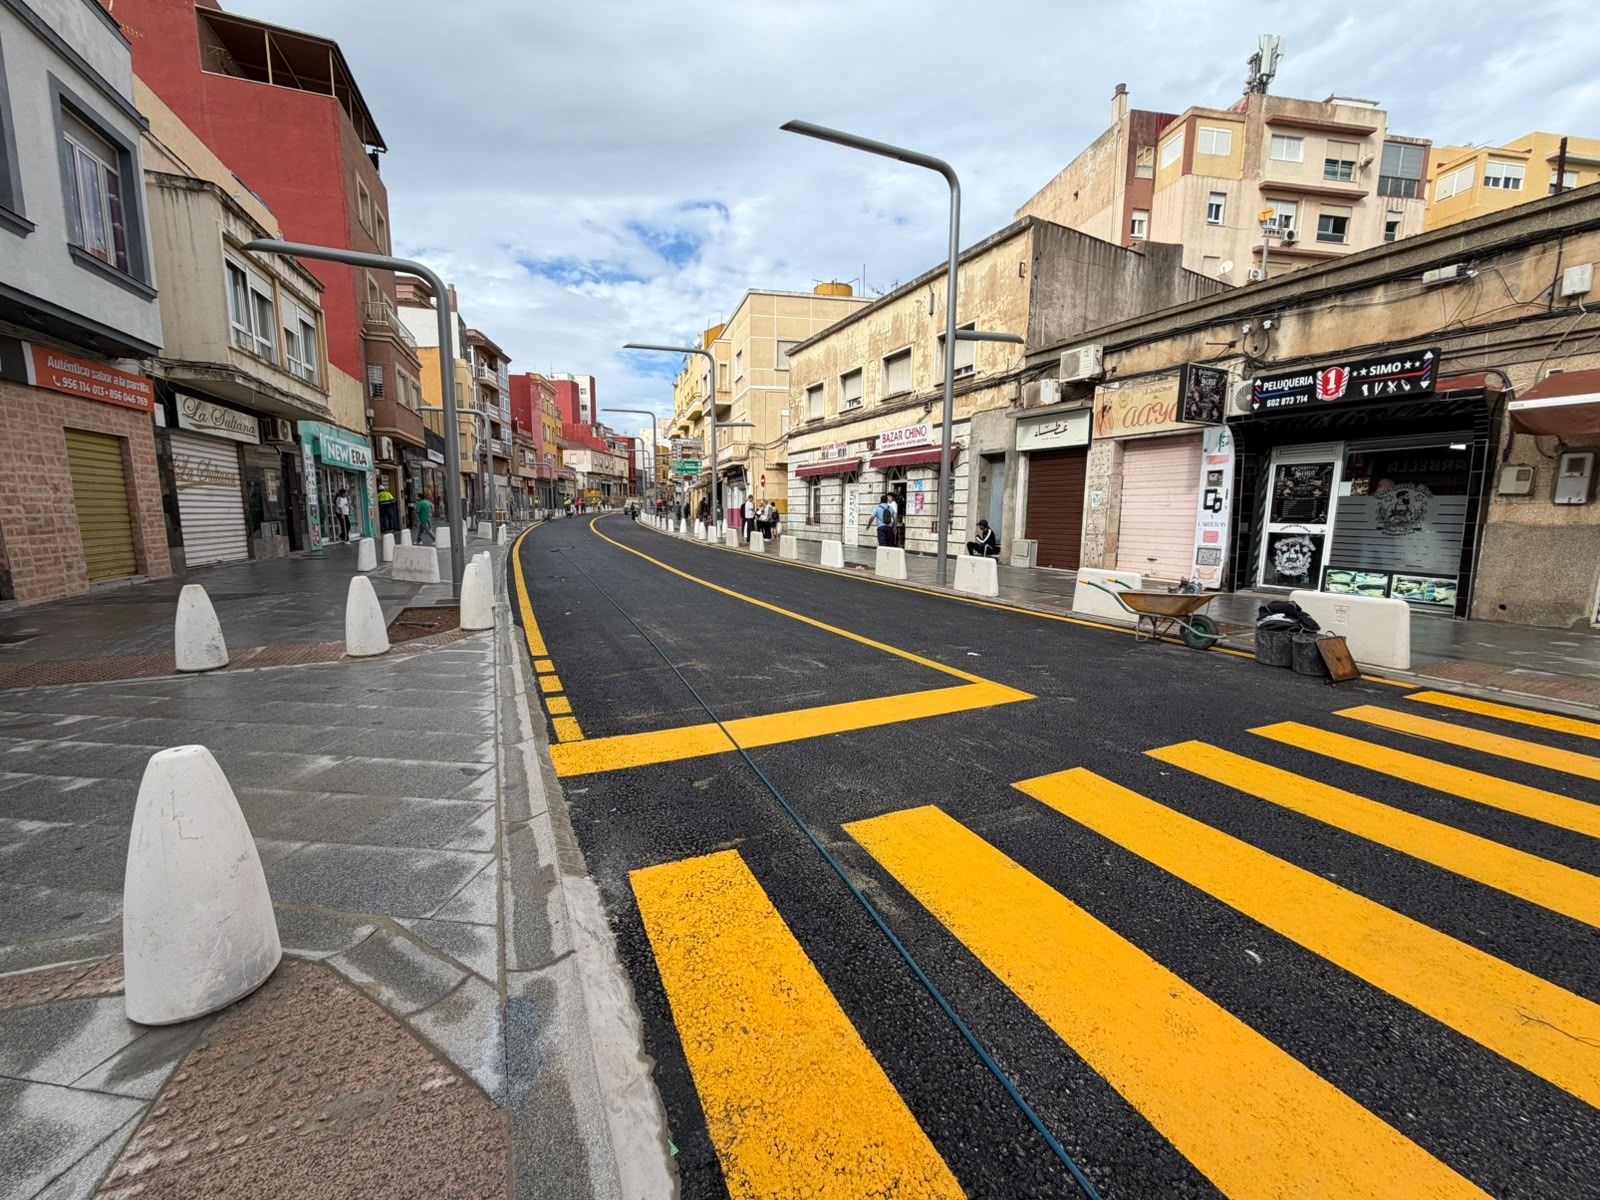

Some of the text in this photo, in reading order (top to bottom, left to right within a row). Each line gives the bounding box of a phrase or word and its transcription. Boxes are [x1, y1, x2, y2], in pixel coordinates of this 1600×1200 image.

[48, 355, 90, 377] Auténtico
[1369, 361, 1401, 376] SIMO
[1263, 376, 1314, 391] PELUQUERIA
[182, 397, 256, 433] La Sultana
[882, 431, 903, 444] BAZAR
[905, 425, 927, 440] CHINO
[326, 440, 368, 467] NEW ERA
